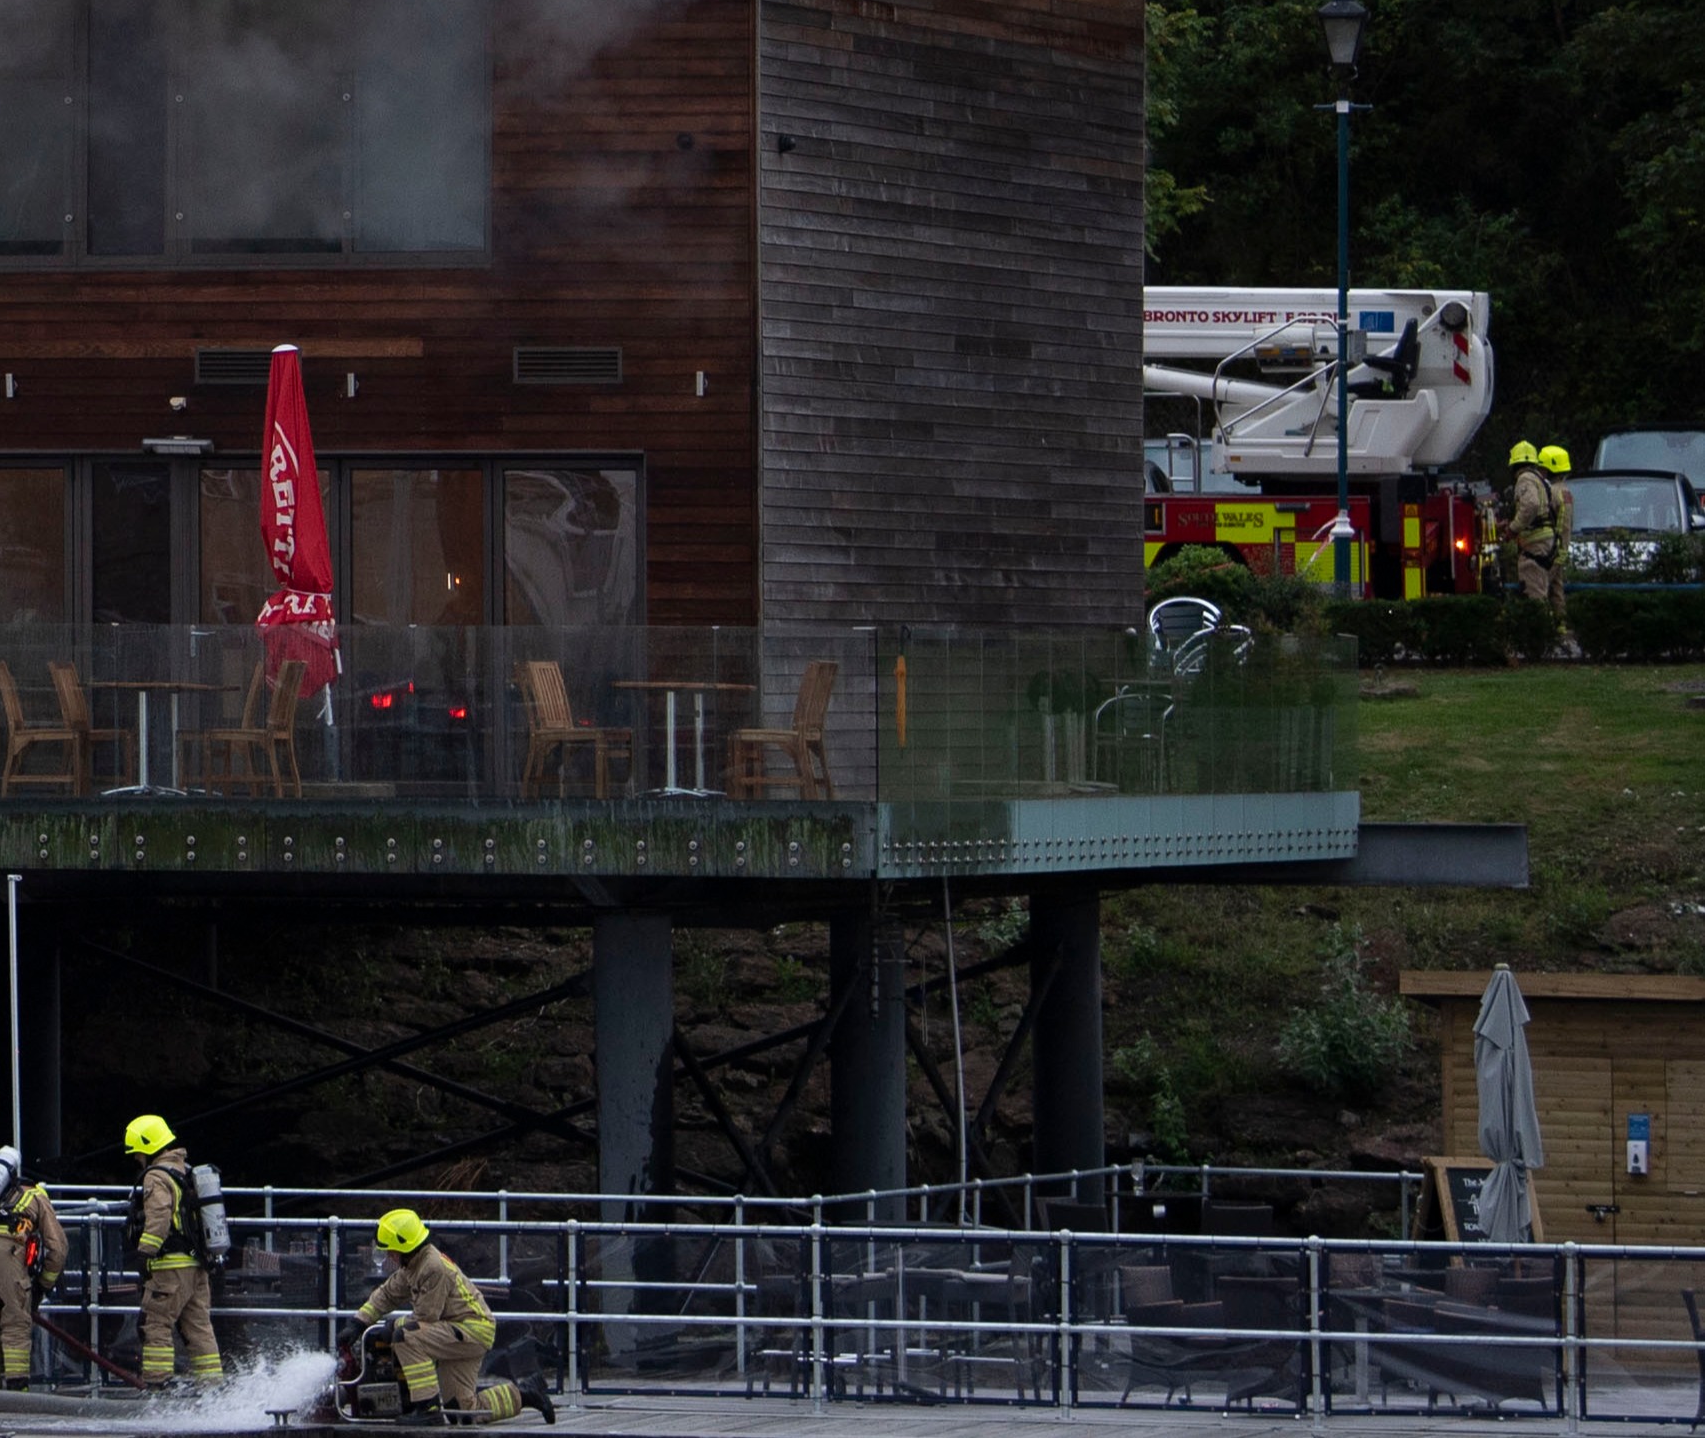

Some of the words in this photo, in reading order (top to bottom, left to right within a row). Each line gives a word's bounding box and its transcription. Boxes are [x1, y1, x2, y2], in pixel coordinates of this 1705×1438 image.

[1143, 310, 1209, 323] BRONTO
[1212, 310, 1278, 324] SKYLIFT
[1222, 512, 1264, 528] WALES
